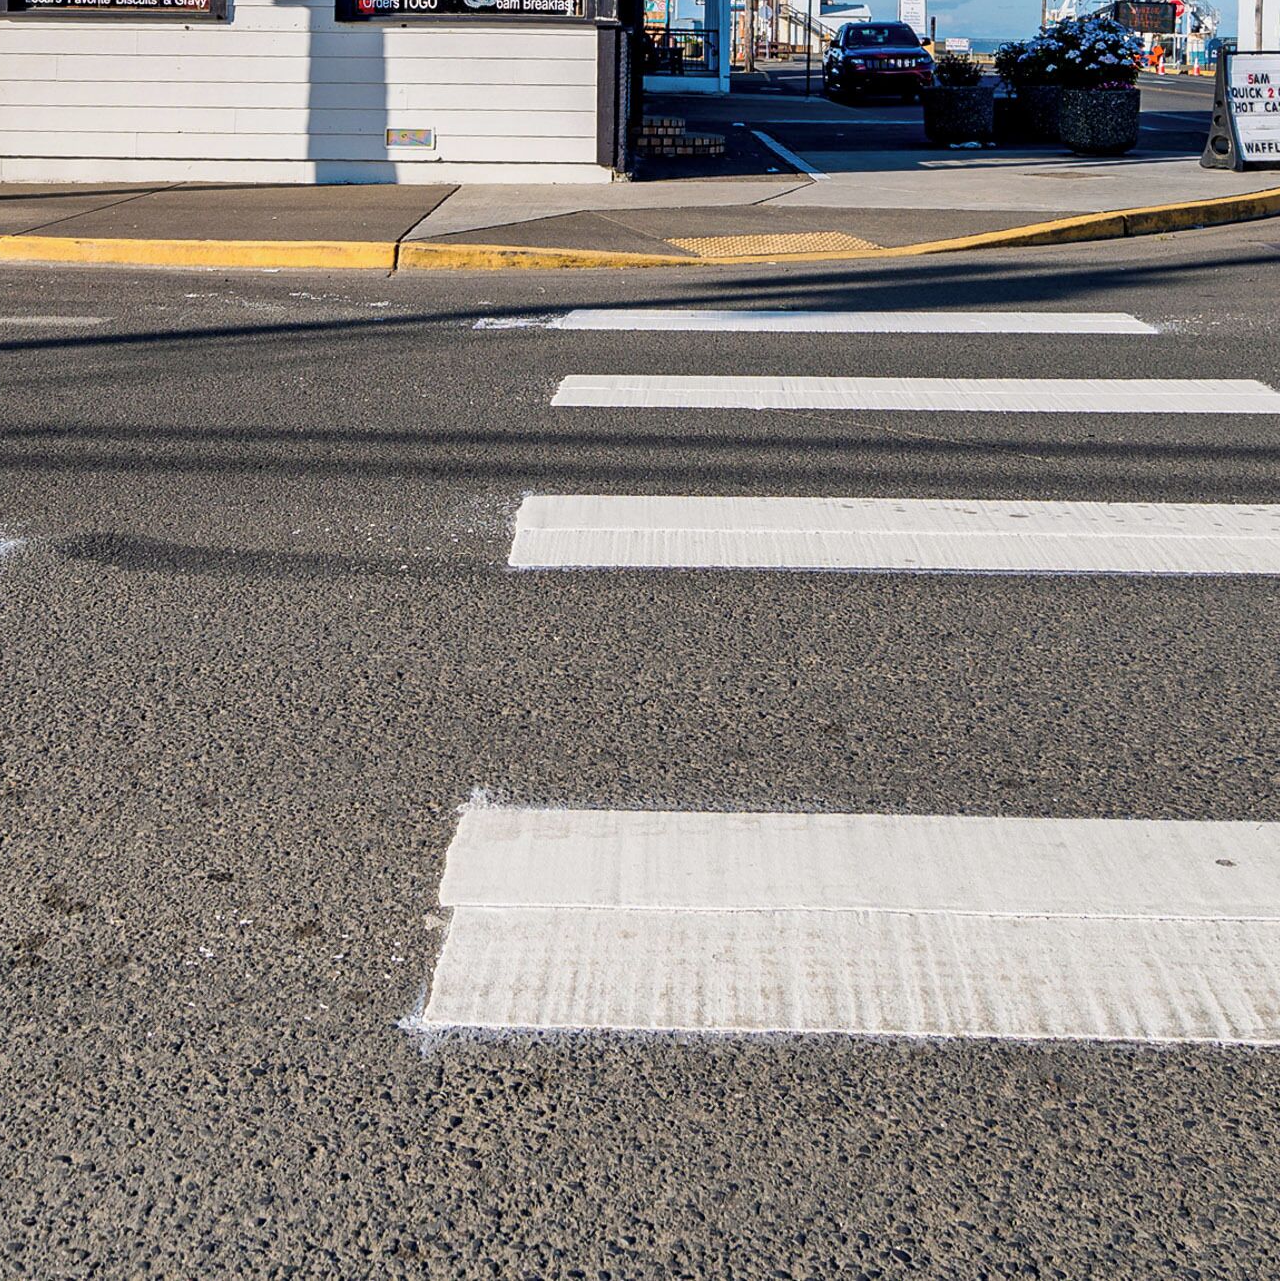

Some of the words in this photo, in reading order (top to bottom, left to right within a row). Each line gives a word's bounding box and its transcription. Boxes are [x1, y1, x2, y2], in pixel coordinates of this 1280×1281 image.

[1247, 73, 1270, 84] 5AM
[1231, 87, 1262, 99] QUICK
[1267, 87, 1274, 99] 2
[1235, 101, 1255, 113] HOT
